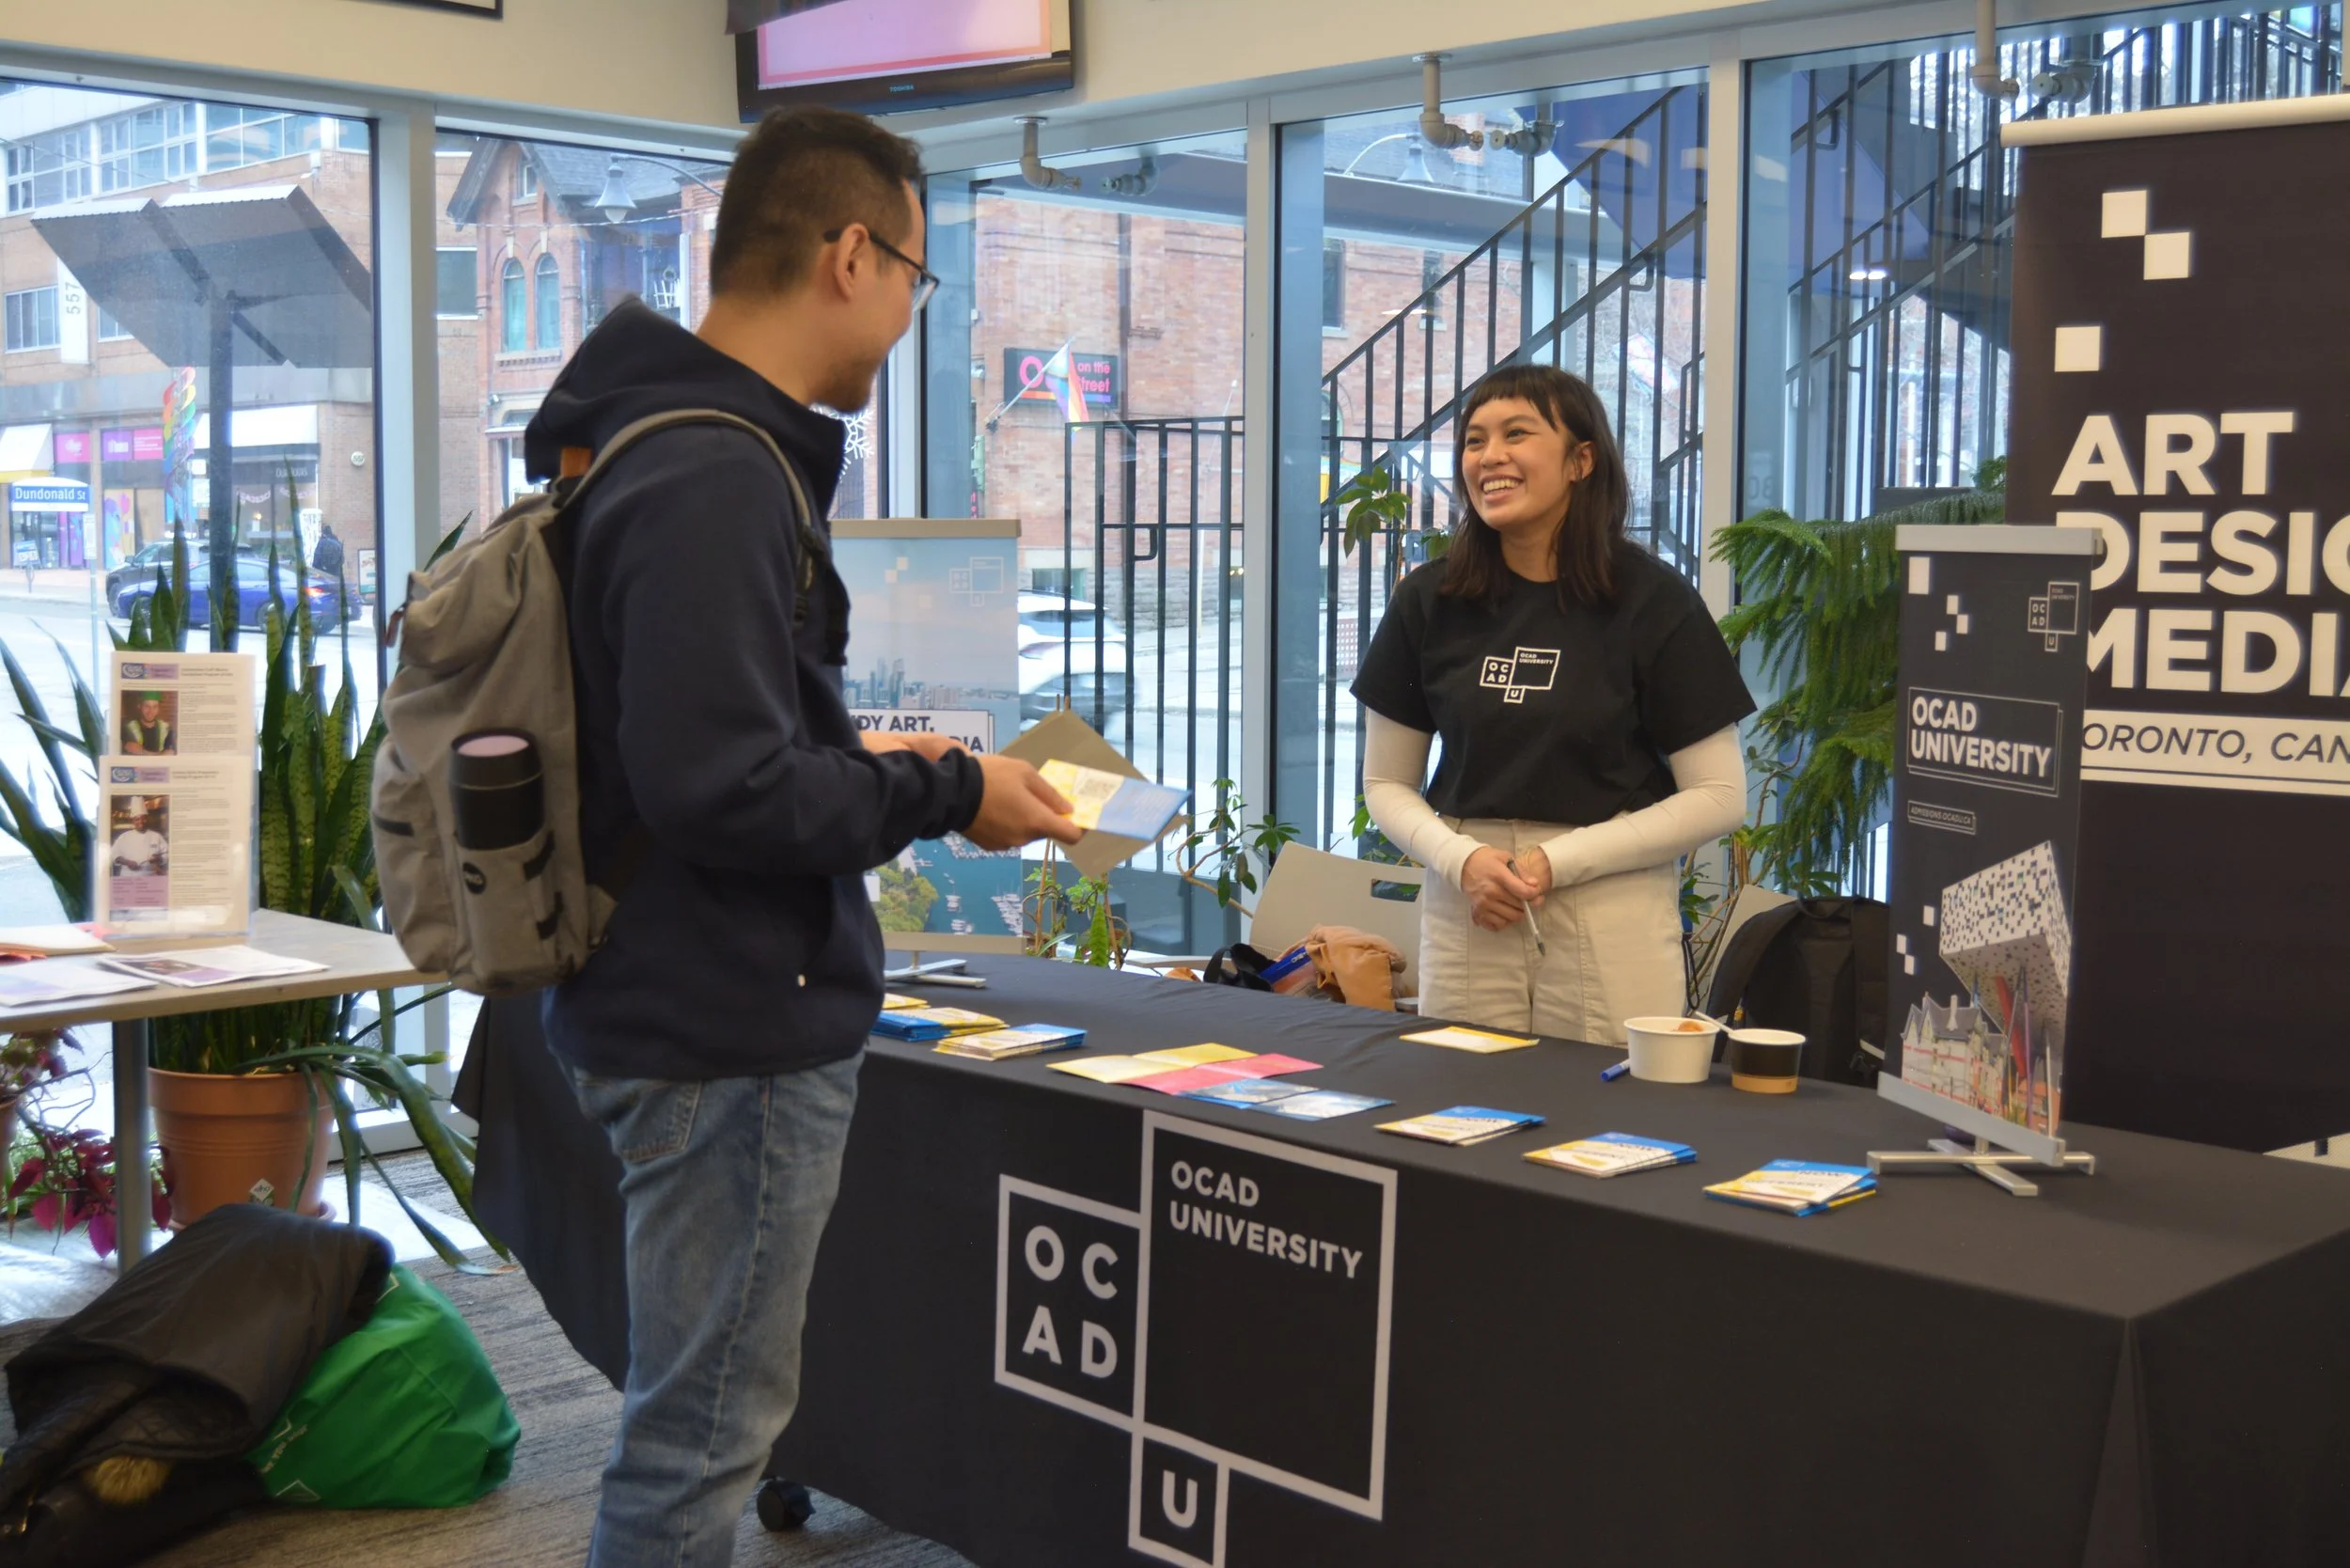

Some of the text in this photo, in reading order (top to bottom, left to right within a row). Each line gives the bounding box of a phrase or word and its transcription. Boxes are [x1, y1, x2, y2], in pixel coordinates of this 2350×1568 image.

[65, 282, 81, 315] 557
[1077, 361, 1111, 374] on the
[1079, 377, 1111, 392] treet
[2051, 411, 2295, 496] ART
[15, 487, 74, 500] Dundonald
[2086, 607, 2350, 698] MEDI
[1511, 689, 1520, 698] U
[851, 714, 935, 732] DY ART.
[1911, 696, 1978, 732] OCAD
[1910, 729, 2052, 778] UNIVERSITY
[2082, 723, 2252, 763] ORONTO,
[1170, 1160, 1260, 1207] OCAD
[1169, 1200, 1363, 1279] UNIVERSITY
[1162, 1469, 1198, 1529] U
